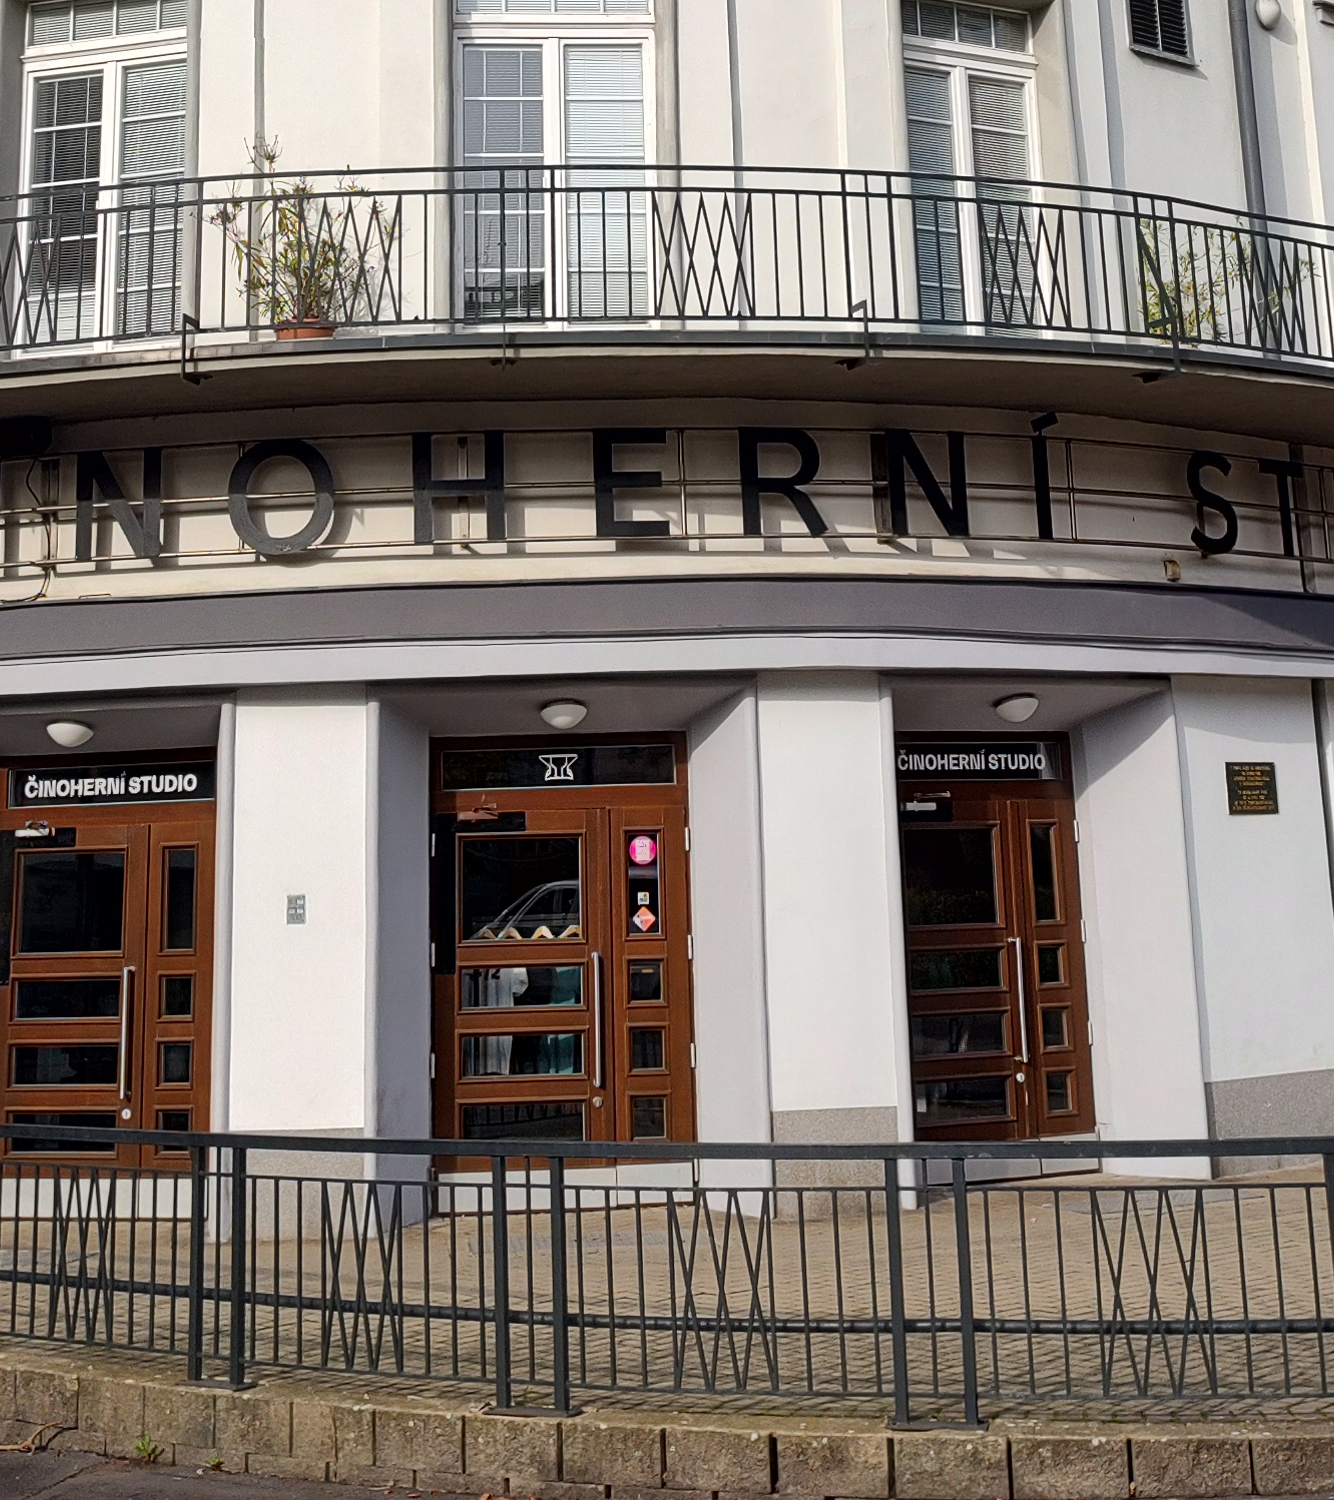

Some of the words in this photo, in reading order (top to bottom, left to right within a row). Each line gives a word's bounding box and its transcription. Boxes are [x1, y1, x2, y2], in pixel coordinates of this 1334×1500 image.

[898, 749, 986, 771] ČINOHERNÍ
[988, 753, 1046, 770] STUDIO
[24, 771, 127, 799] ČINOHERNÍ
[128, 773, 198, 794] STUDIO
